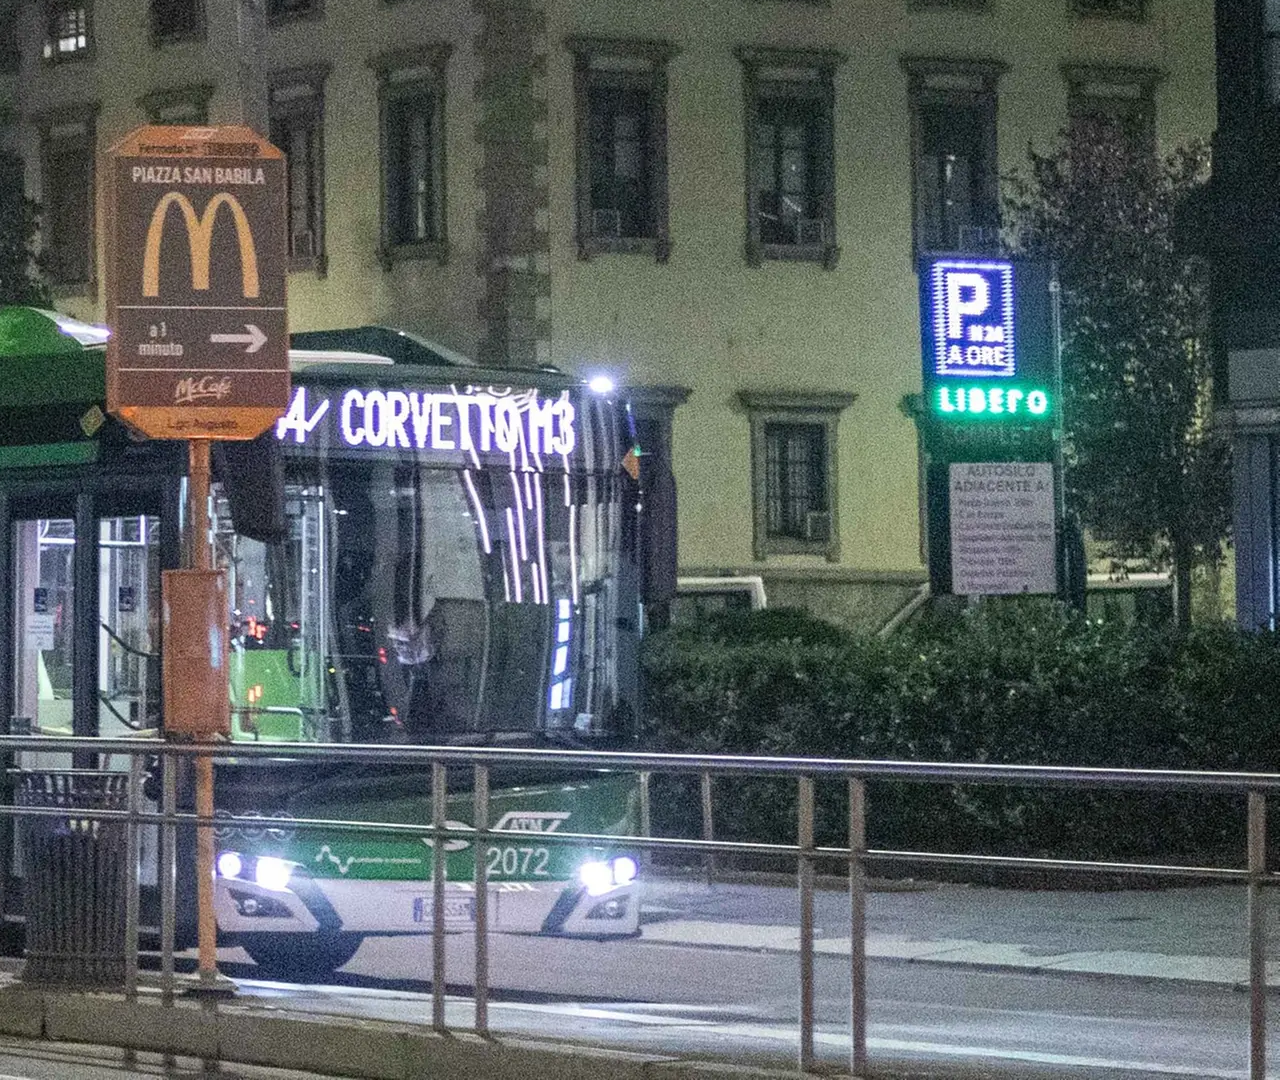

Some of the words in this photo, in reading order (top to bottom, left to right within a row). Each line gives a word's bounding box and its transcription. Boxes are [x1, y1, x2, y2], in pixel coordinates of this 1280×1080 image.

[132, 166, 181, 183] PIAZZA
[184, 167, 213, 183] SAN
[215, 167, 265, 184] BABILA
[946, 273, 990, 338] P
[149, 325, 158, 337] a
[139, 340, 183, 356] minuto
[947, 345, 964, 366] A
[966, 346, 1007, 366] ORE
[340, 389, 519, 452] CORVETTO
[528, 392, 576, 454] M3
[968, 465, 1035, 477] AUTOSILO
[954, 479, 1031, 492] ADIACENTE
[486, 846, 550, 876] 2072
